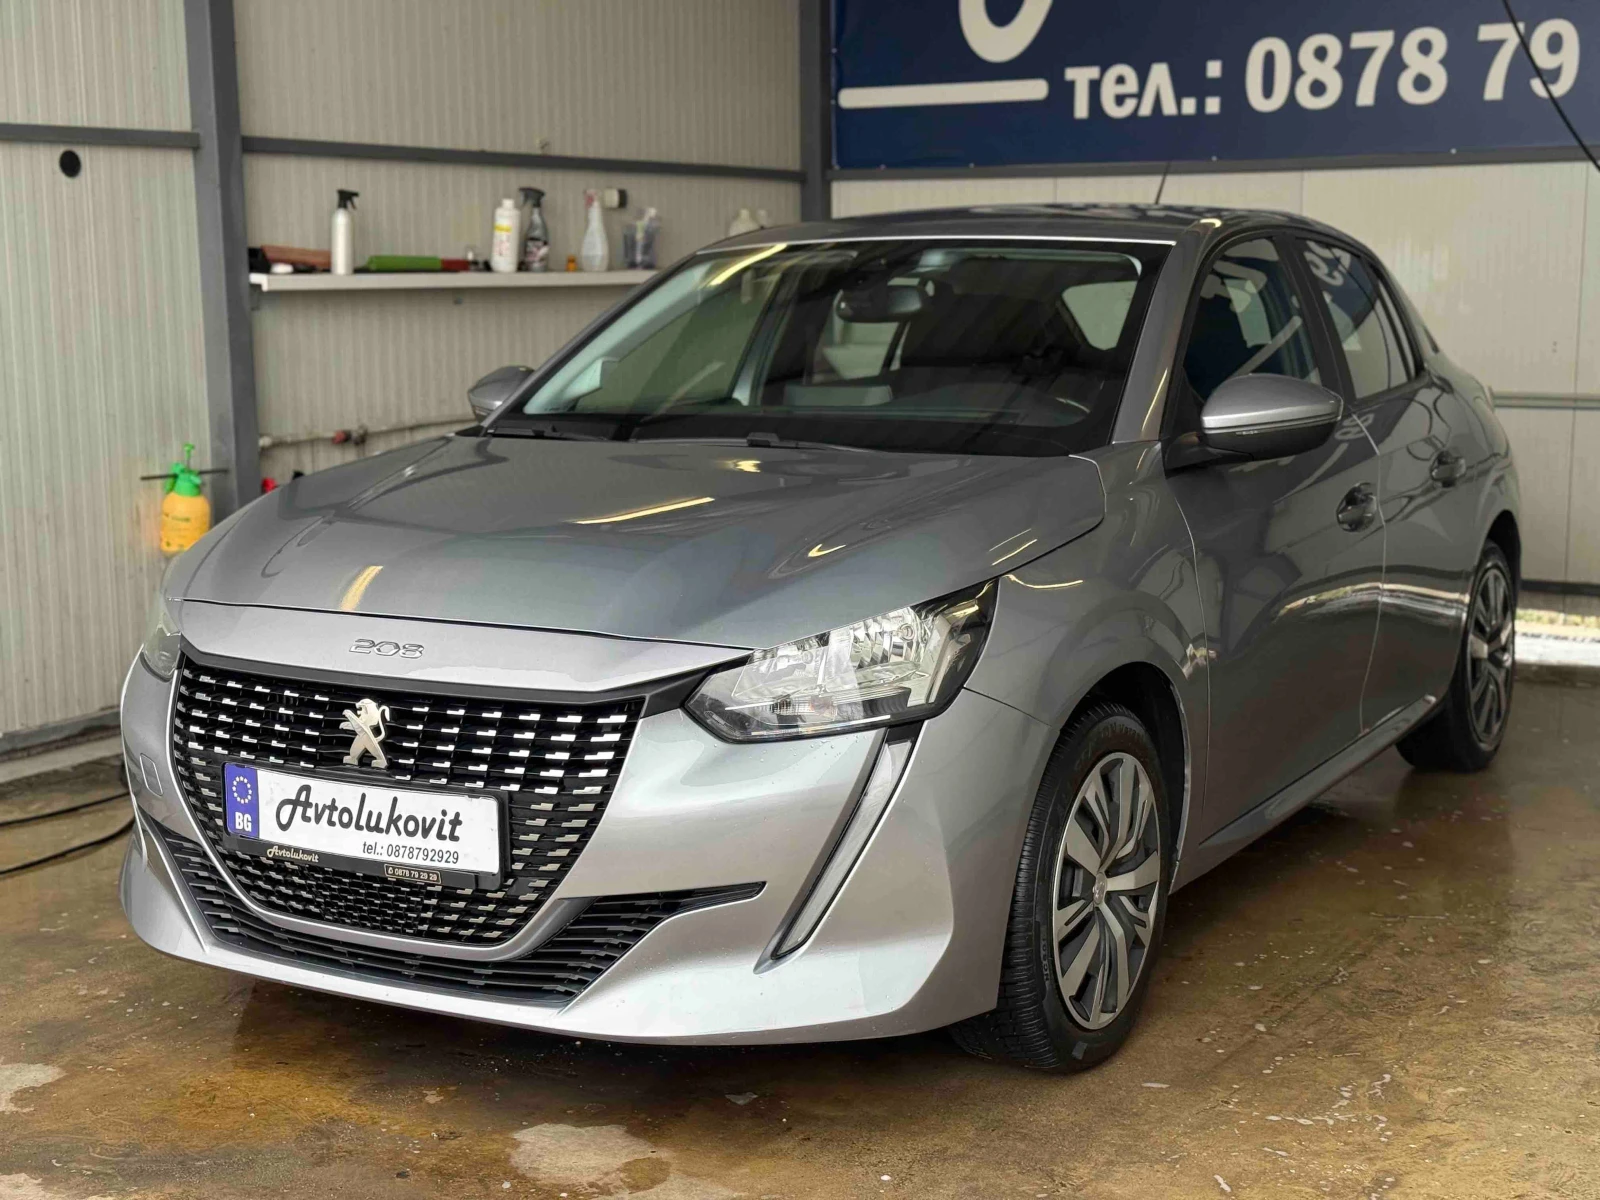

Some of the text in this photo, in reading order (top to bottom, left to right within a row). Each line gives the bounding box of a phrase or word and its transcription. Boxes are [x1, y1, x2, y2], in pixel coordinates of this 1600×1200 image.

[1064, 18, 1580, 120] тел.: 0878 79
[348, 638, 425, 659] 208
[235, 811, 252, 832] BG
[275, 784, 463, 842] Avtolukovit
[266, 845, 319, 863] Avtolukovit
[362, 841, 459, 864] tel.: 0878792929
